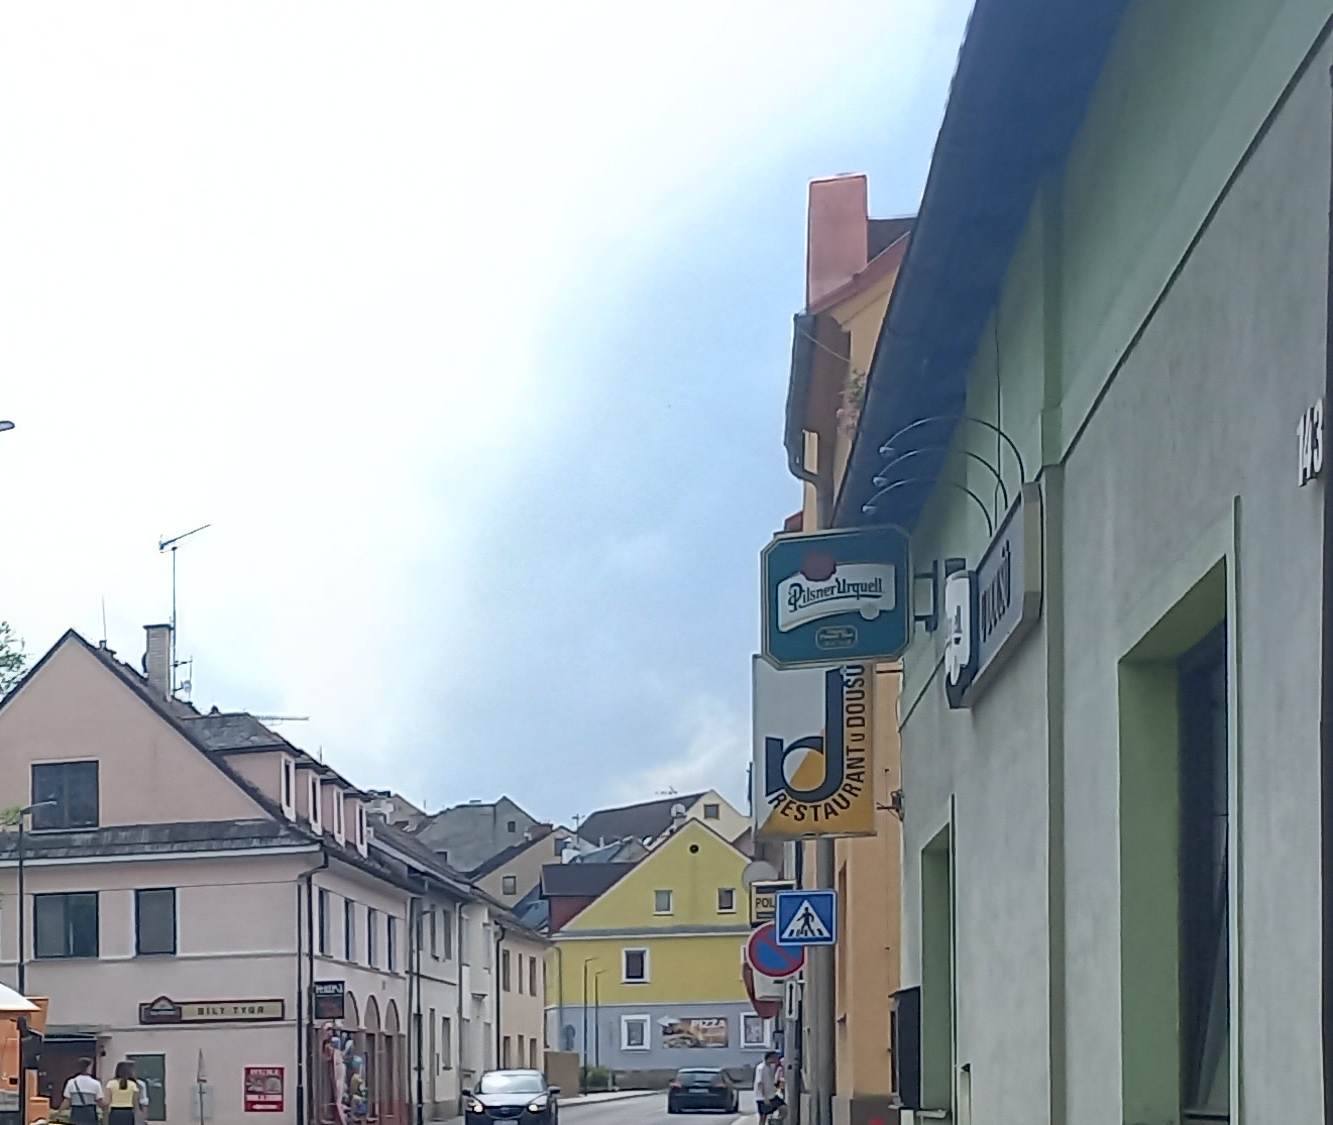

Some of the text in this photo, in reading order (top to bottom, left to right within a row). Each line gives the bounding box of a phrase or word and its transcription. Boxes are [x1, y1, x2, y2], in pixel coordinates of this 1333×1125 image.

[1296, 398, 1323, 487] 143
[788, 577, 883, 613] Pilsner Urquell
[767, 745, 866, 822] RESTAURANT
